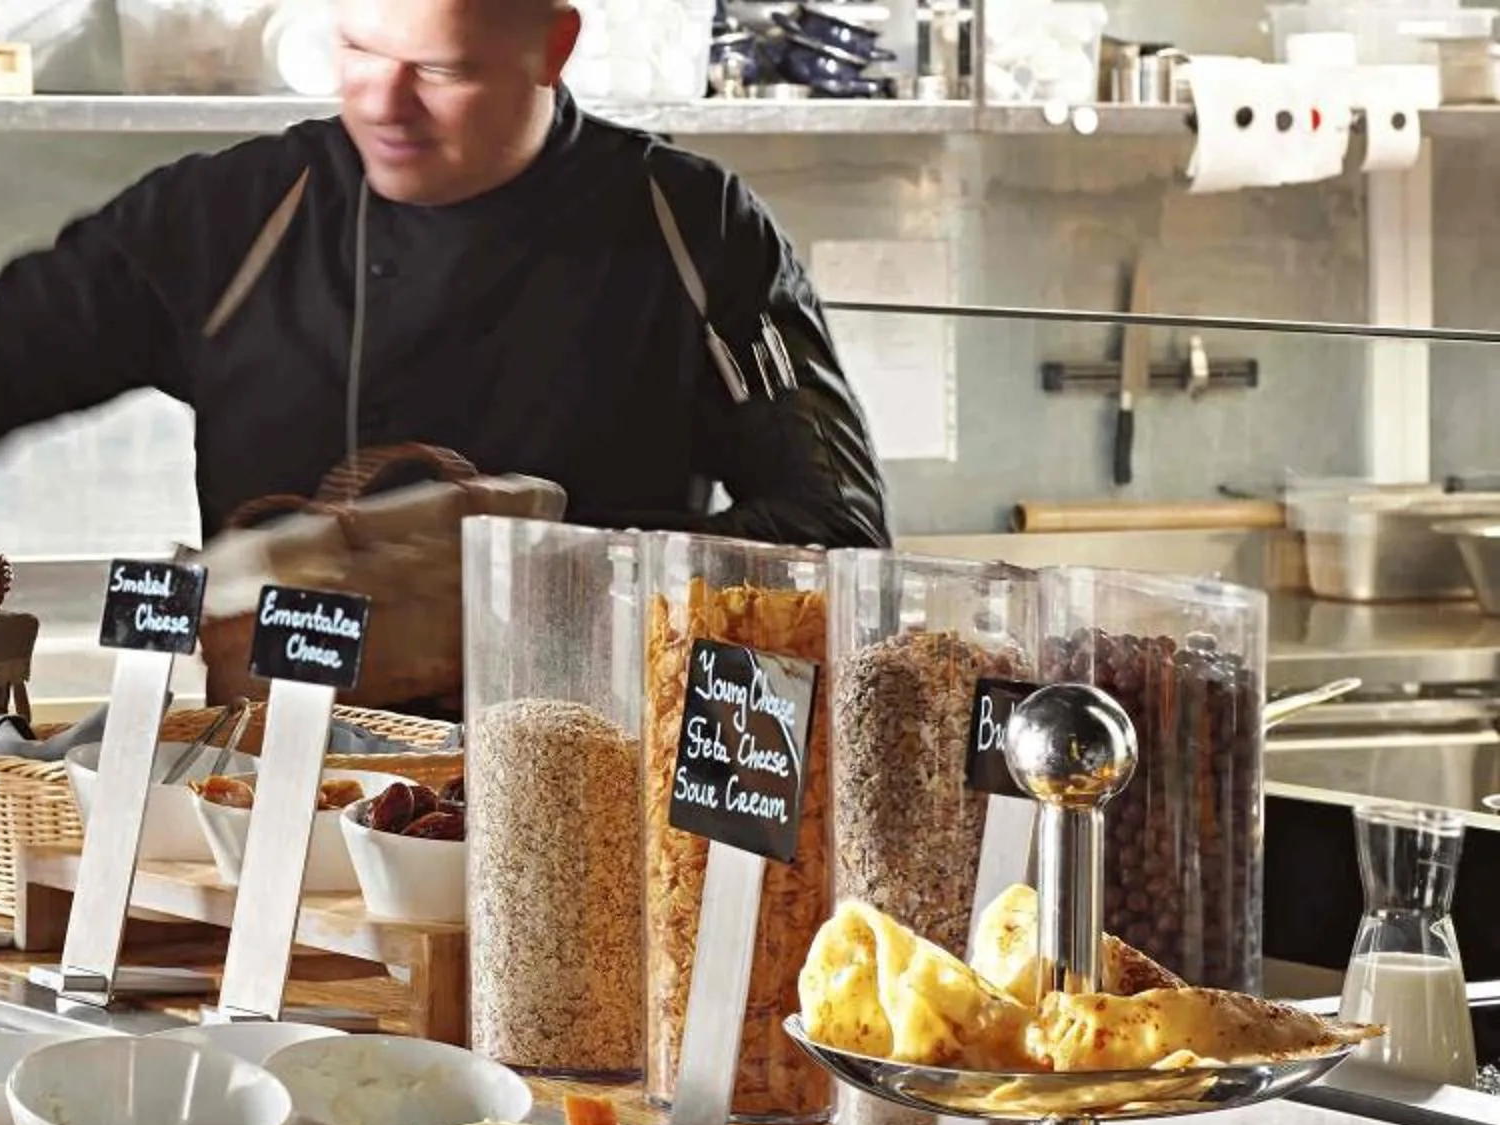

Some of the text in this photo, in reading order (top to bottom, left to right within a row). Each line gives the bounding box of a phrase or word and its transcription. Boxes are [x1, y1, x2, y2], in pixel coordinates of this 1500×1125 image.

[110, 566, 173, 597] Smoked
[135, 603, 190, 634] Cheese
[286, 633, 343, 668] Cheese
[695, 649, 796, 732] Young Cheese
[687, 715, 790, 777] Feta Cheese
[673, 765, 789, 824] Sour Cream
